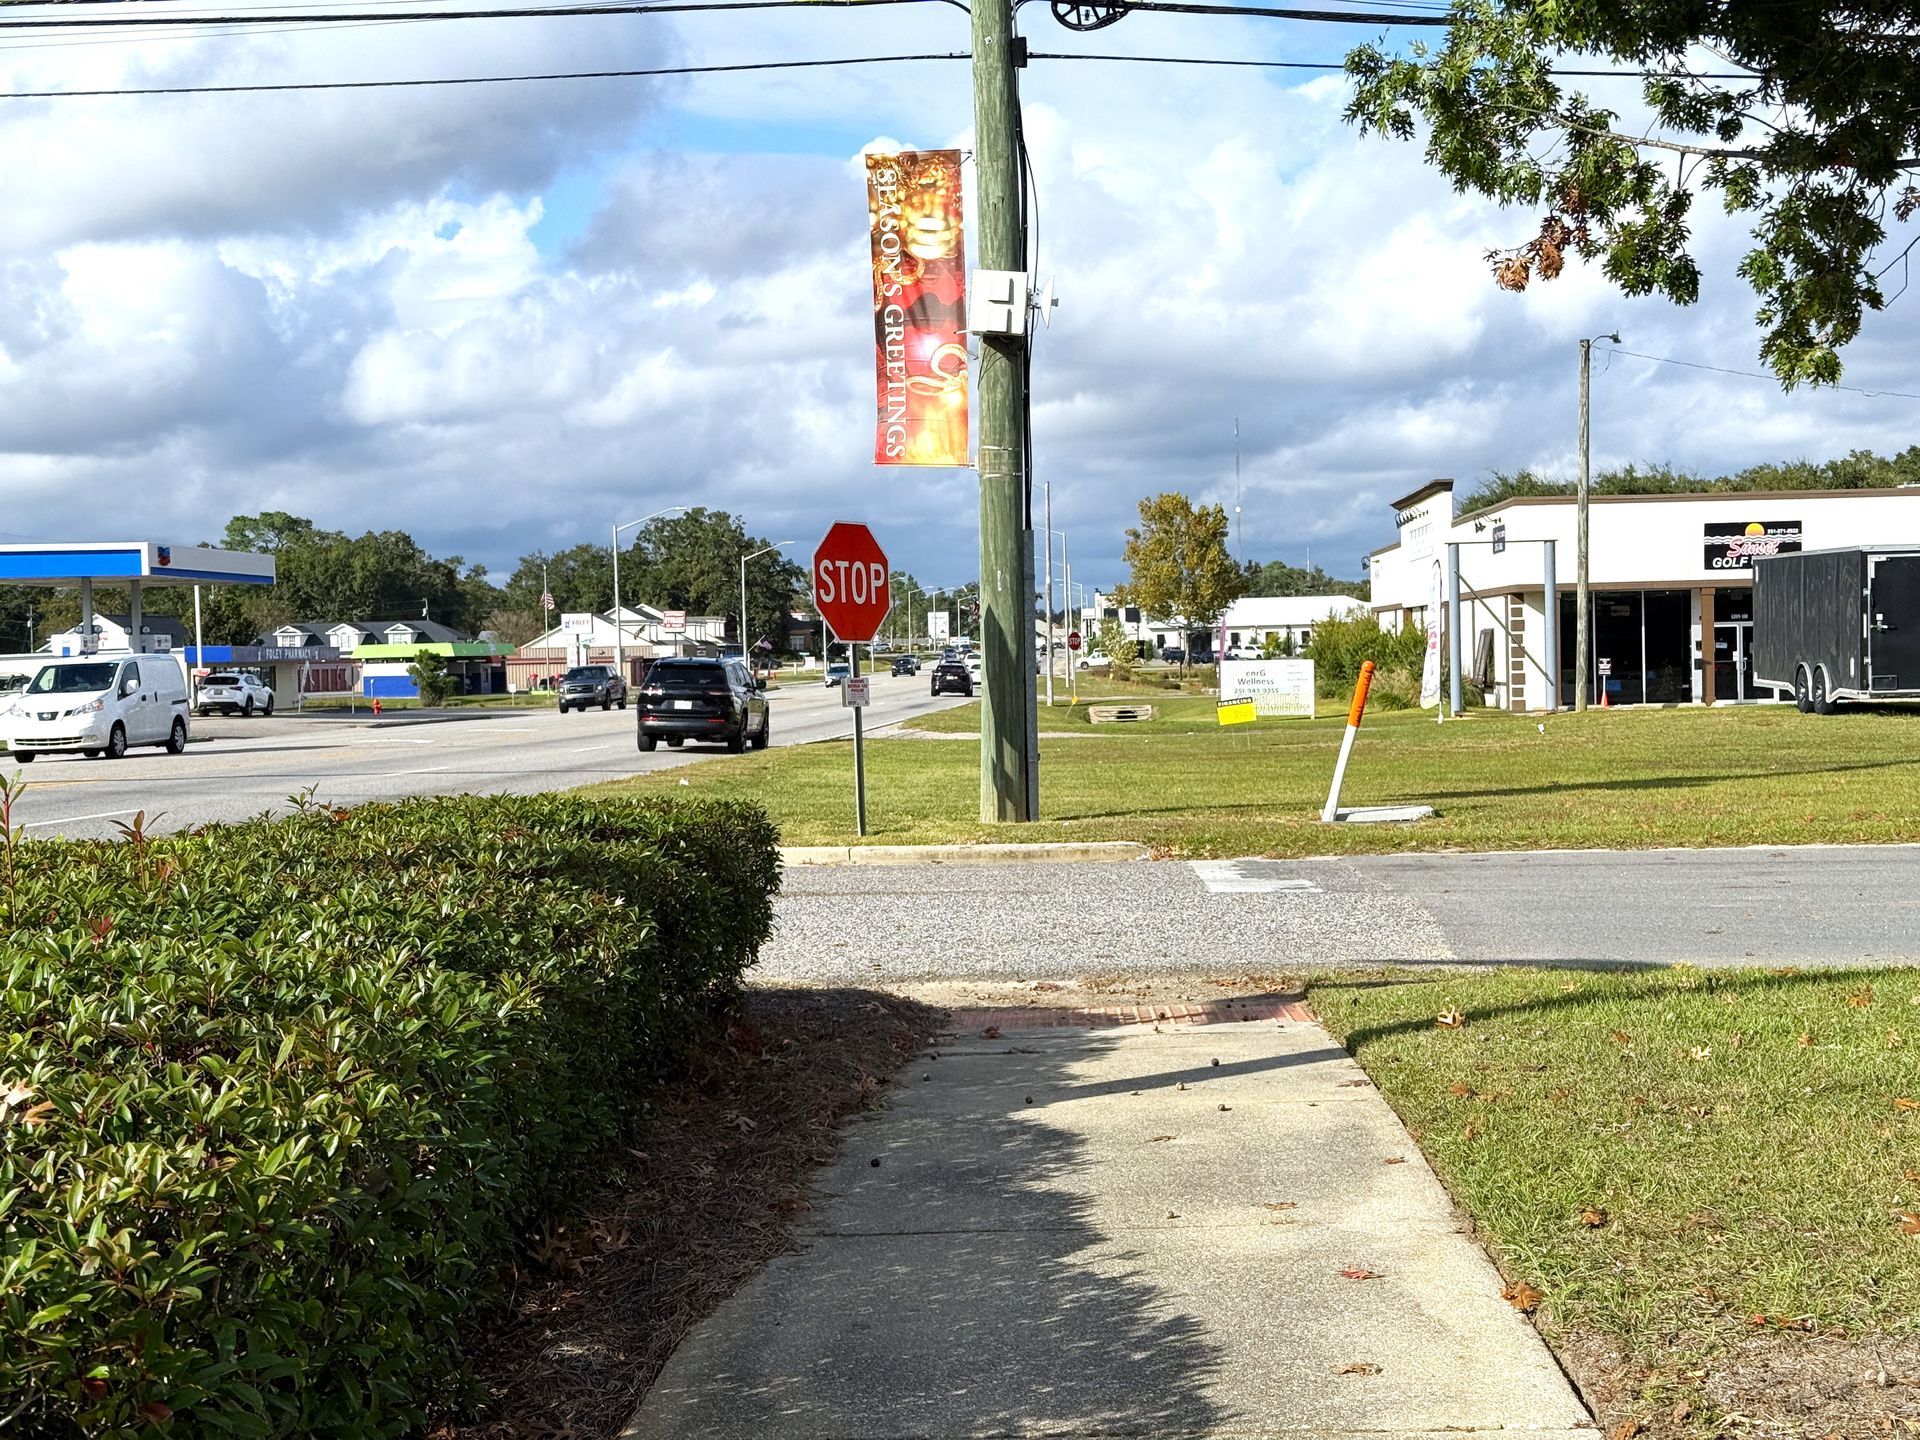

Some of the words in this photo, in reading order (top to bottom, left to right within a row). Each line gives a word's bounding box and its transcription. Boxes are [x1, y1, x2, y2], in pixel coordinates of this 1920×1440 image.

[877, 168, 902, 297] SEASON'S
[884, 304, 907, 458] GREETINGS
[1727, 535, 1780, 557] Sunset
[1712, 556, 1749, 568] GOLF
[819, 559, 885, 604] STOP
[1069, 637, 1081, 645] STOP
[266, 648, 282, 660] FOLEY
[284, 648, 311, 660] PHARMACY
